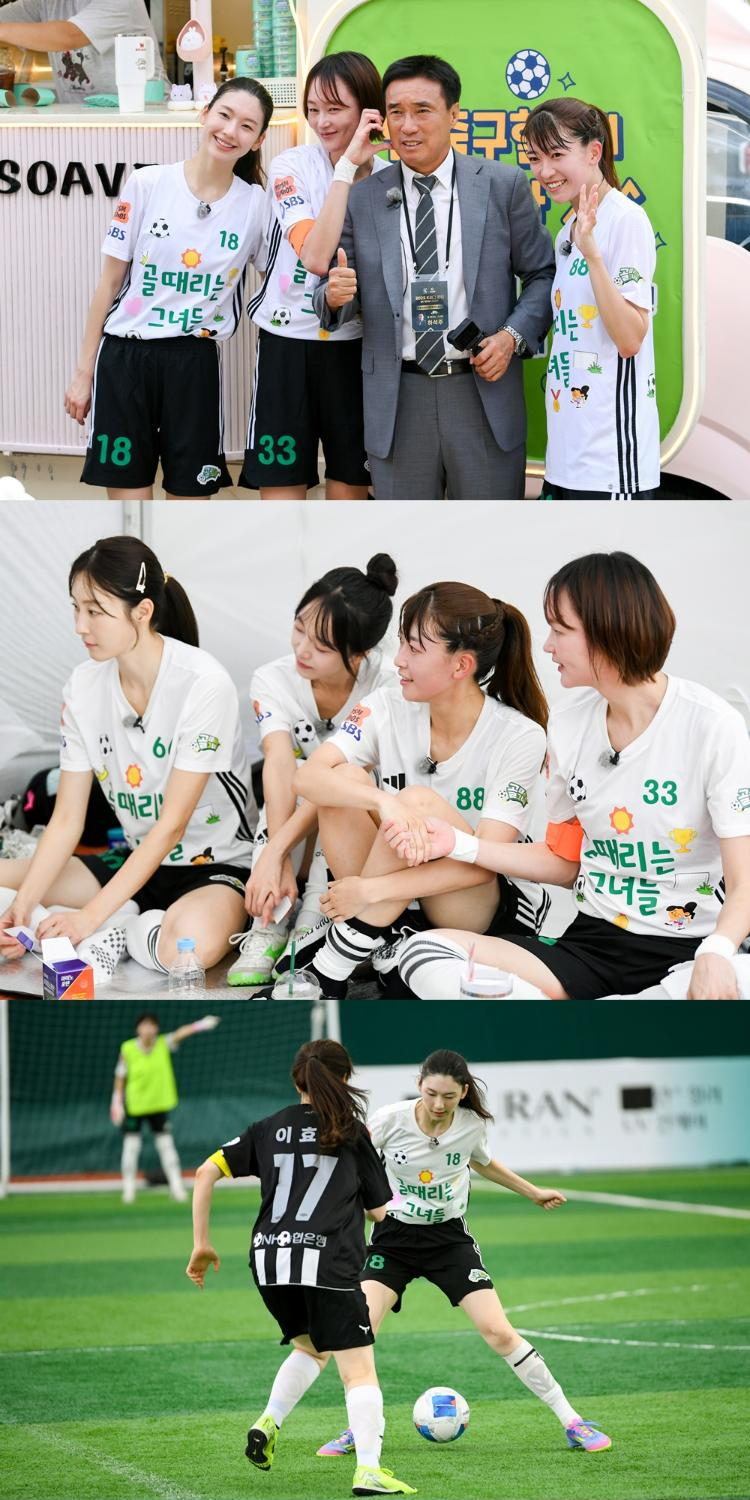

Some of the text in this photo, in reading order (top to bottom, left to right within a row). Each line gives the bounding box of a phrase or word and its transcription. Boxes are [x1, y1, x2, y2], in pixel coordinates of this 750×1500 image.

[0, 159, 159, 198] SOAV
[284, 195, 305, 209] SBS
[219, 230, 239, 251] 18
[569, 258, 589, 276] 88
[141, 263, 226, 302] 골때리는
[96, 434, 133, 466] 18
[257, 434, 297, 466] 33
[341, 721, 362, 742] SBS
[152, 736, 173, 758] 6
[456, 786, 485, 811] 88
[642, 778, 678, 806] 33
[445, 1152, 461, 1166] 18
[270, 1152, 339, 1224] 17
